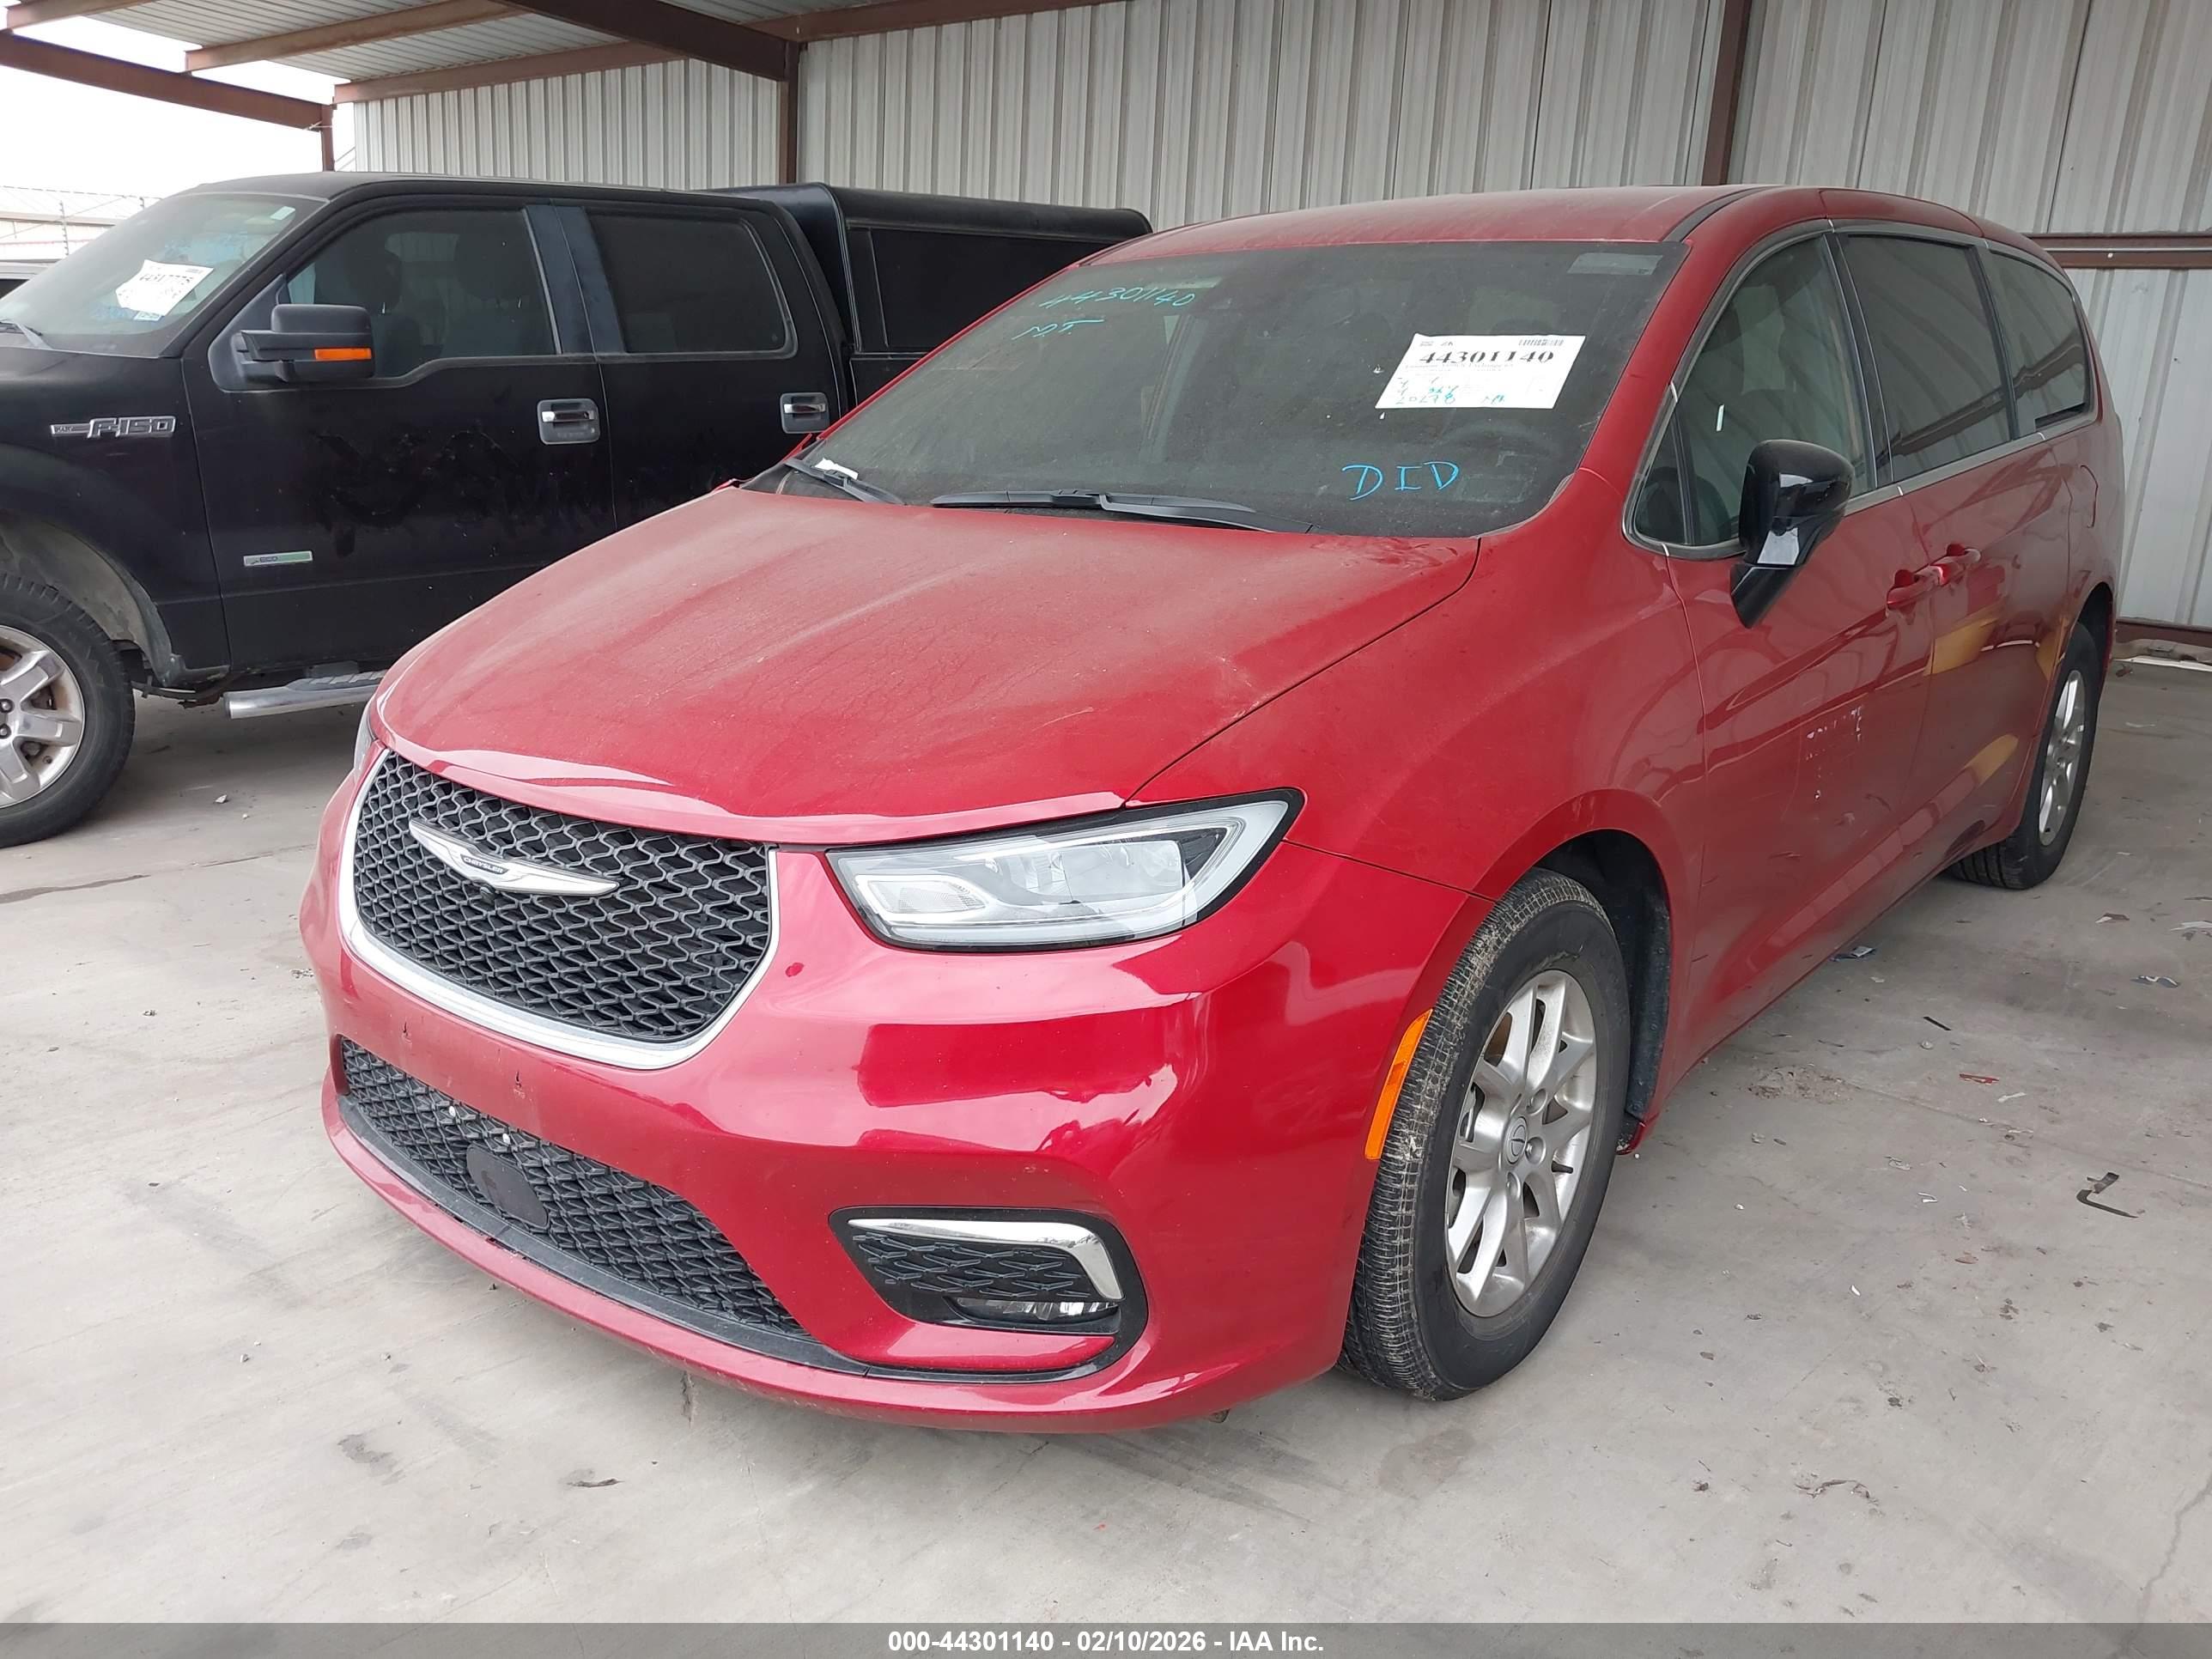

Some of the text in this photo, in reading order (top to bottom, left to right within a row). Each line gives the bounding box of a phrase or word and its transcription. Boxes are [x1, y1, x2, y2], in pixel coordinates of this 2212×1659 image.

[1038, 286, 1196, 309] 44301140
[1419, 349, 1555, 364] 44301140
[87, 416, 177, 439] F-150
[462, 856, 505, 874] CHRYSLER
